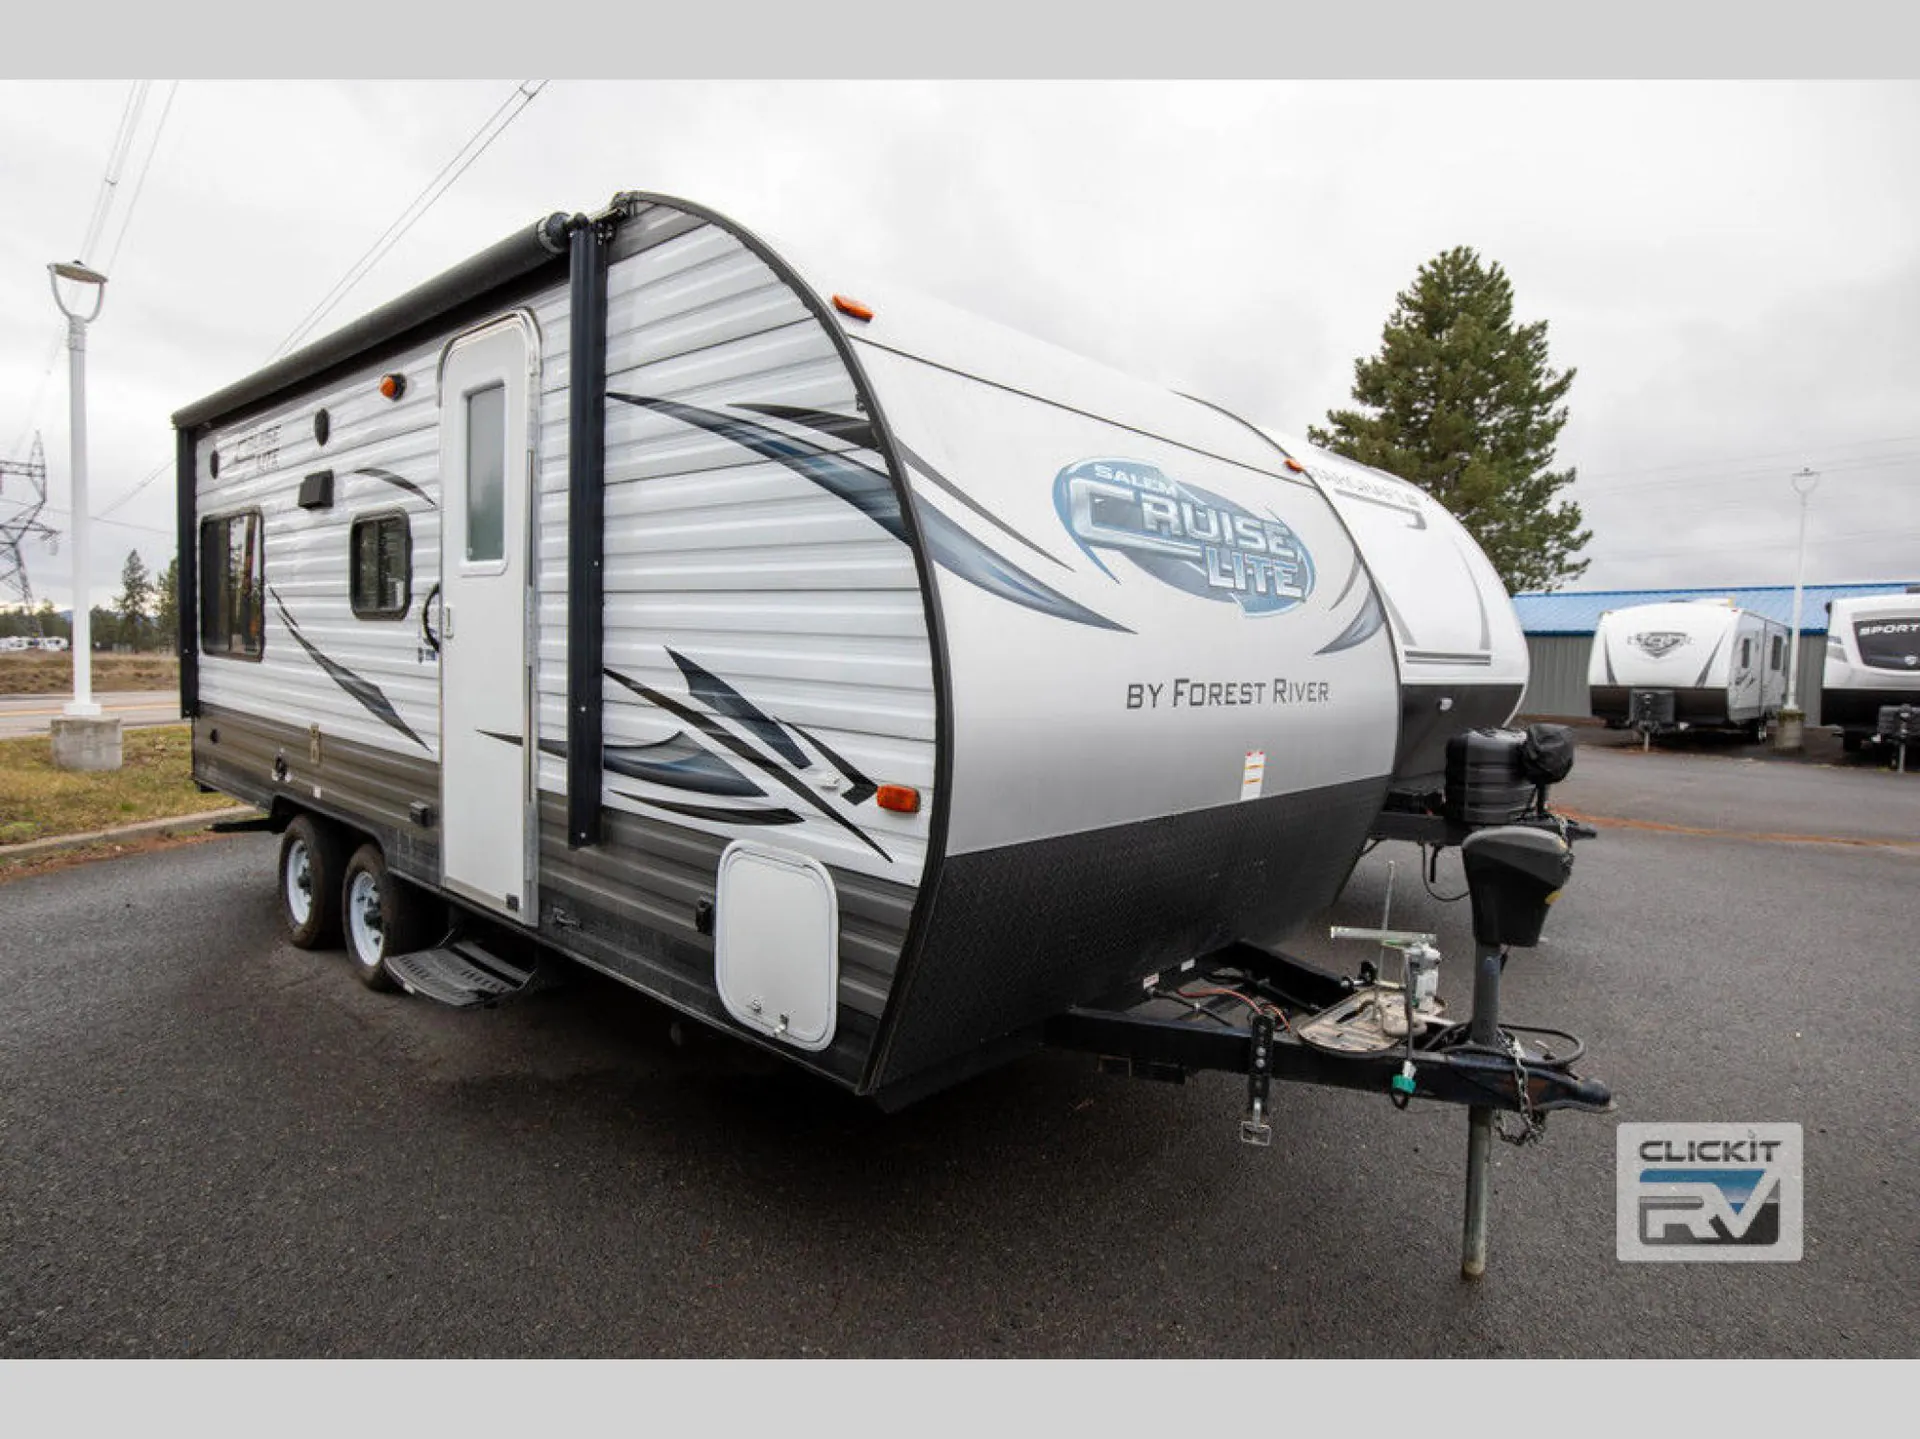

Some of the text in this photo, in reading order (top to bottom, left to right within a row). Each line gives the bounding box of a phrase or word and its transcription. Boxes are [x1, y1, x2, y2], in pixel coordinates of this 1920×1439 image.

[1094, 465, 1177, 495] SALEM
[1069, 478, 1296, 557] CRUISE
[1206, 546, 1303, 599] LITE
[1127, 678, 1329, 709] BY FOREST RIVER
